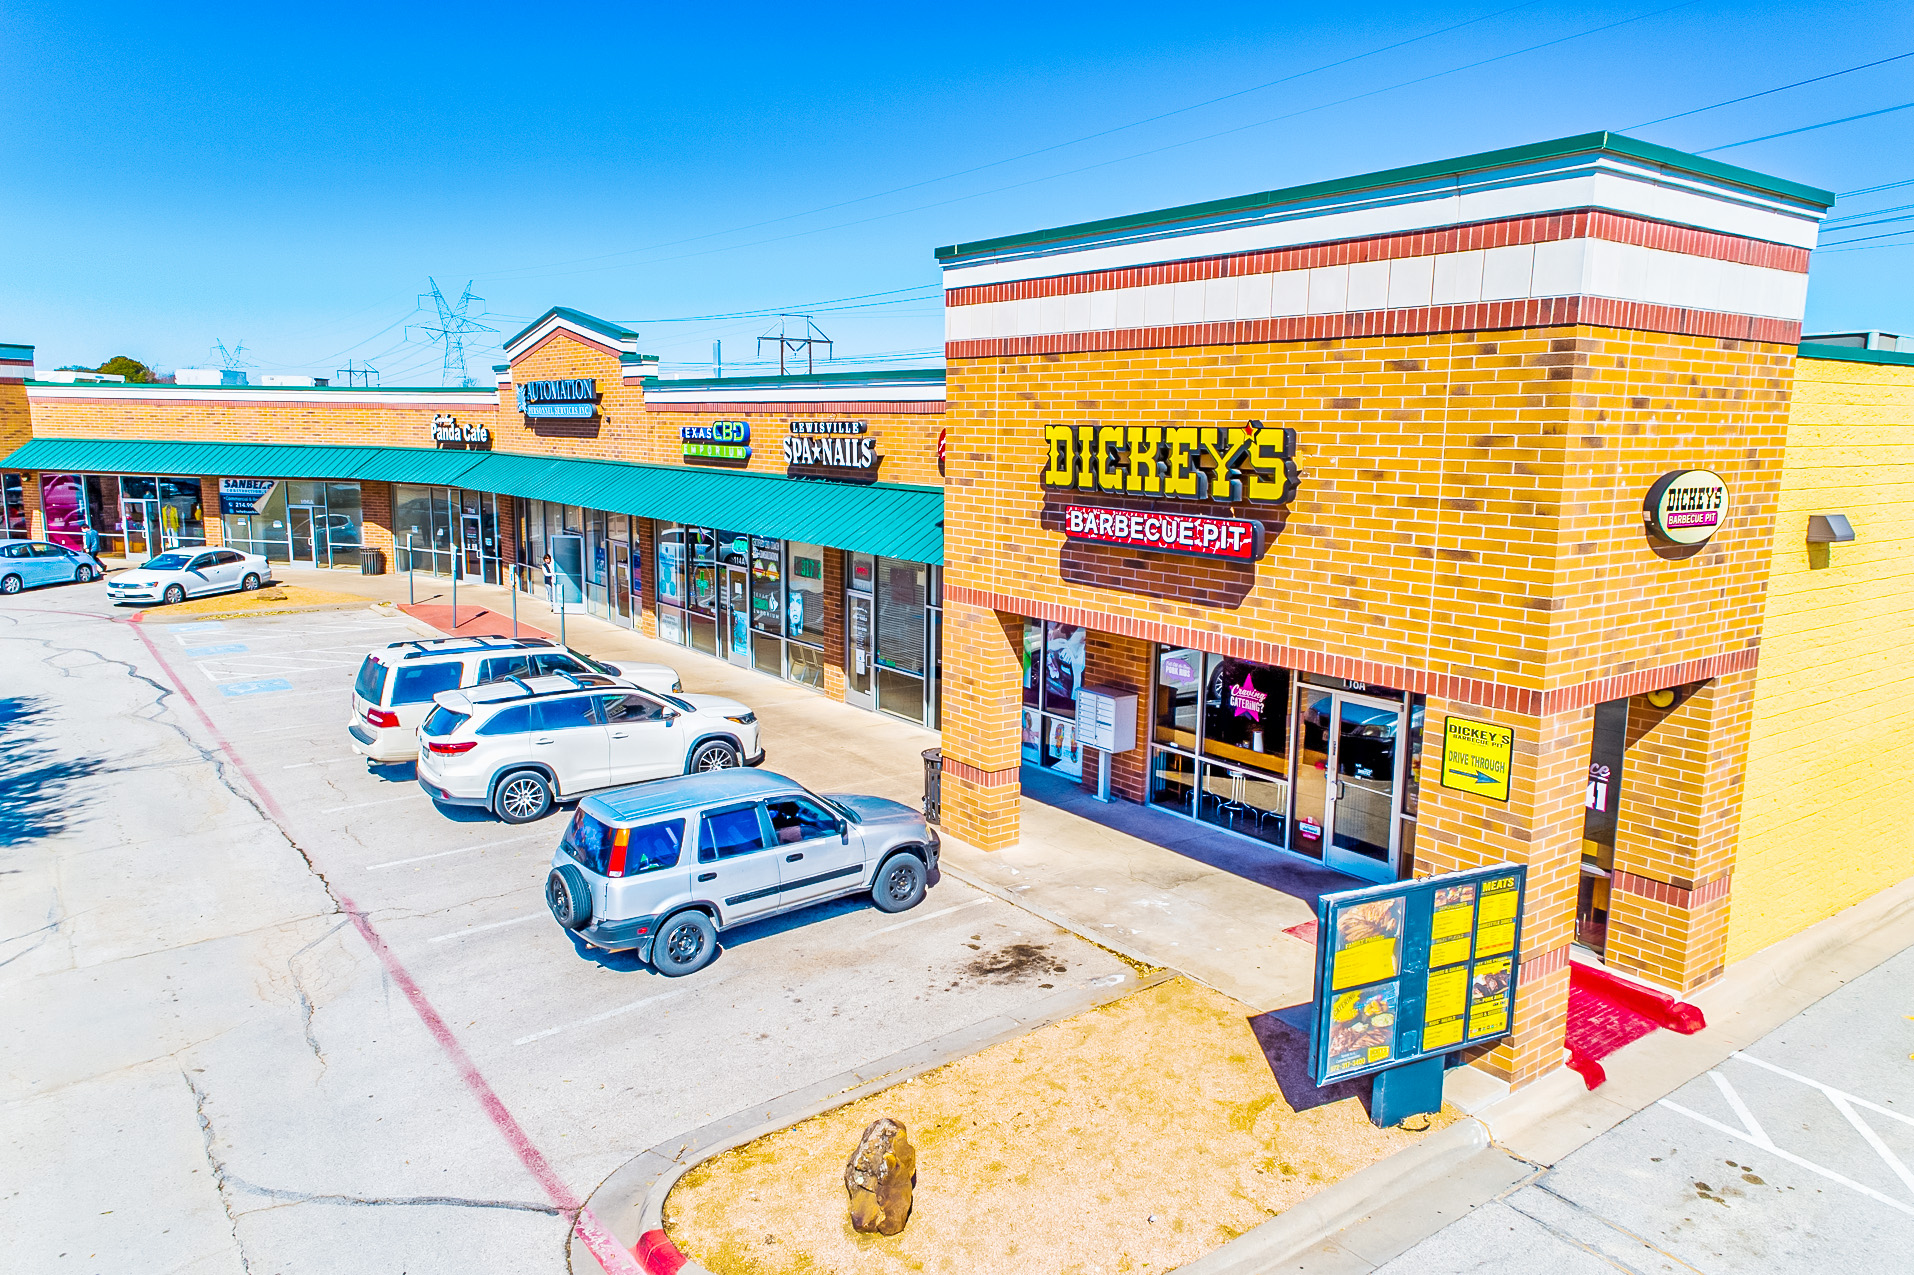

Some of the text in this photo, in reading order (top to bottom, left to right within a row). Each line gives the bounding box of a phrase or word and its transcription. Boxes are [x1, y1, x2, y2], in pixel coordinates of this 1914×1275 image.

[527, 379, 593, 400] AUTOMATION
[528, 406, 554, 415] PERSONNEL
[555, 406, 578, 415] SERVICES
[430, 422, 488, 442] Panda Cafe
[679, 421, 745, 442] TEXAS CBD
[792, 422, 862, 434] LEWISVILLE
[683, 444, 744, 458] EMPORIUM
[783, 437, 873, 469] SPA NAILS
[1044, 420, 1288, 501] DICKEY'S
[1666, 486, 1723, 512] DICKEY'S
[1668, 512, 1717, 526] BARBECUE PIT
[1070, 510, 1247, 551] BARBECUE PIT
[1231, 683, 1266, 702] Craving
[1448, 724, 1510, 745] DICKEY'S
[1453, 733, 1490, 746] BARBECUE
[1448, 750, 1506, 774] DRIVE THROUGH
[1482, 876, 1515, 893] MEATS
[1333, 992, 1356, 1017] CATERING
